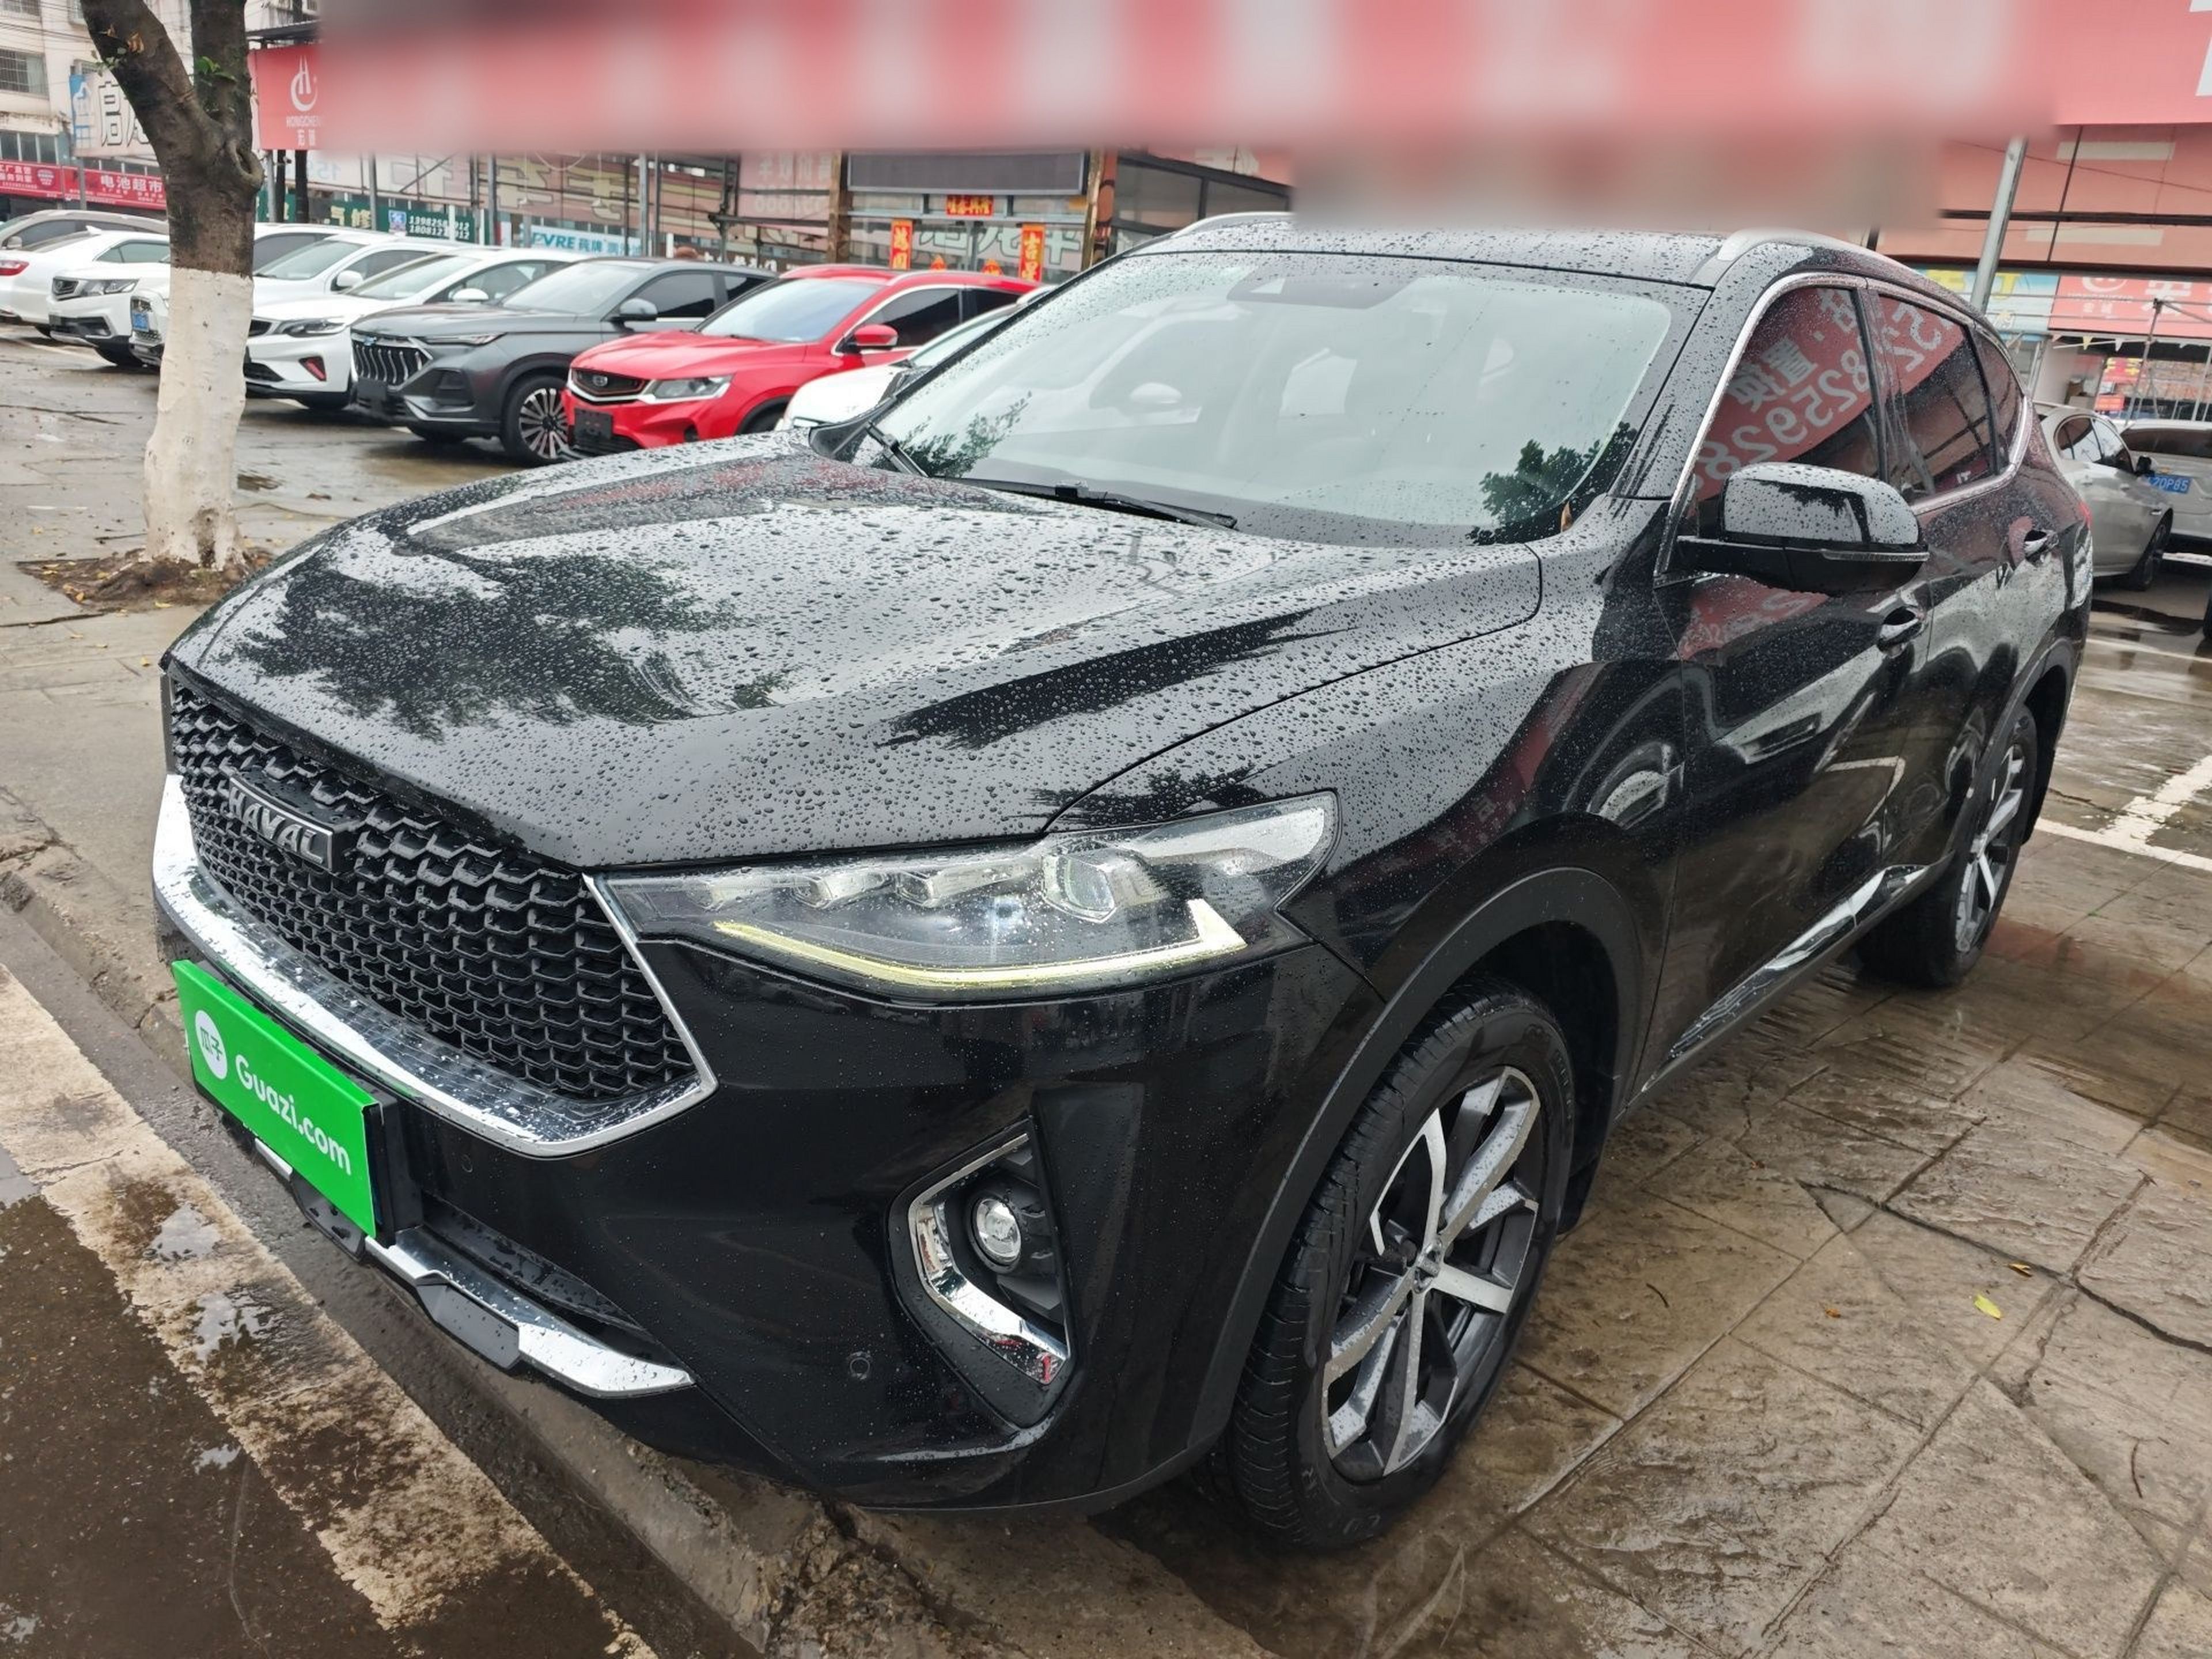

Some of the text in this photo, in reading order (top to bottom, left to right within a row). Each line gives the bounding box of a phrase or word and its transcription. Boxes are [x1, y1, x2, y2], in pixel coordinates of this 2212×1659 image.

[100, 175, 163, 194] 电池超市
[229, 786, 323, 863] HAVAL
[200, 1026, 223, 1062] 瓜子
[236, 1054, 351, 1176] Guazi.com
